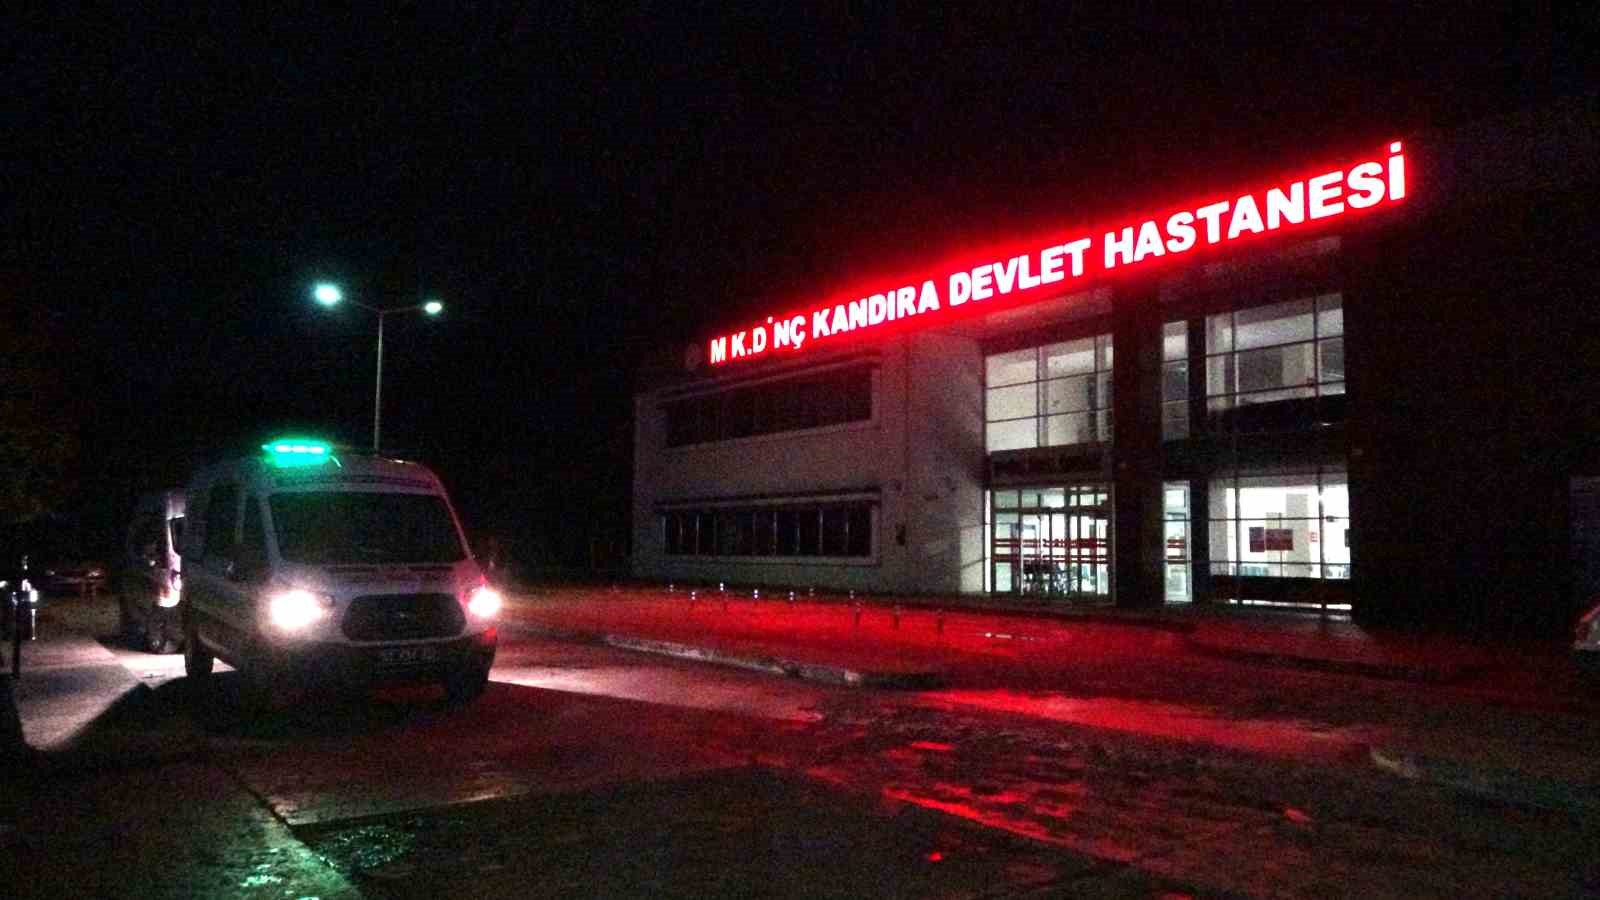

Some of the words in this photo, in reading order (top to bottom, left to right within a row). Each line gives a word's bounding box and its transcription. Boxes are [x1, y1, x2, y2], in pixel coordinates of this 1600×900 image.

[731, 315, 806, 358] K.DNÇ
[812, 279, 941, 338] KANDIRA
[949, 237, 1092, 307] DEVLET
[1104, 141, 1406, 269] HASTANESİ
